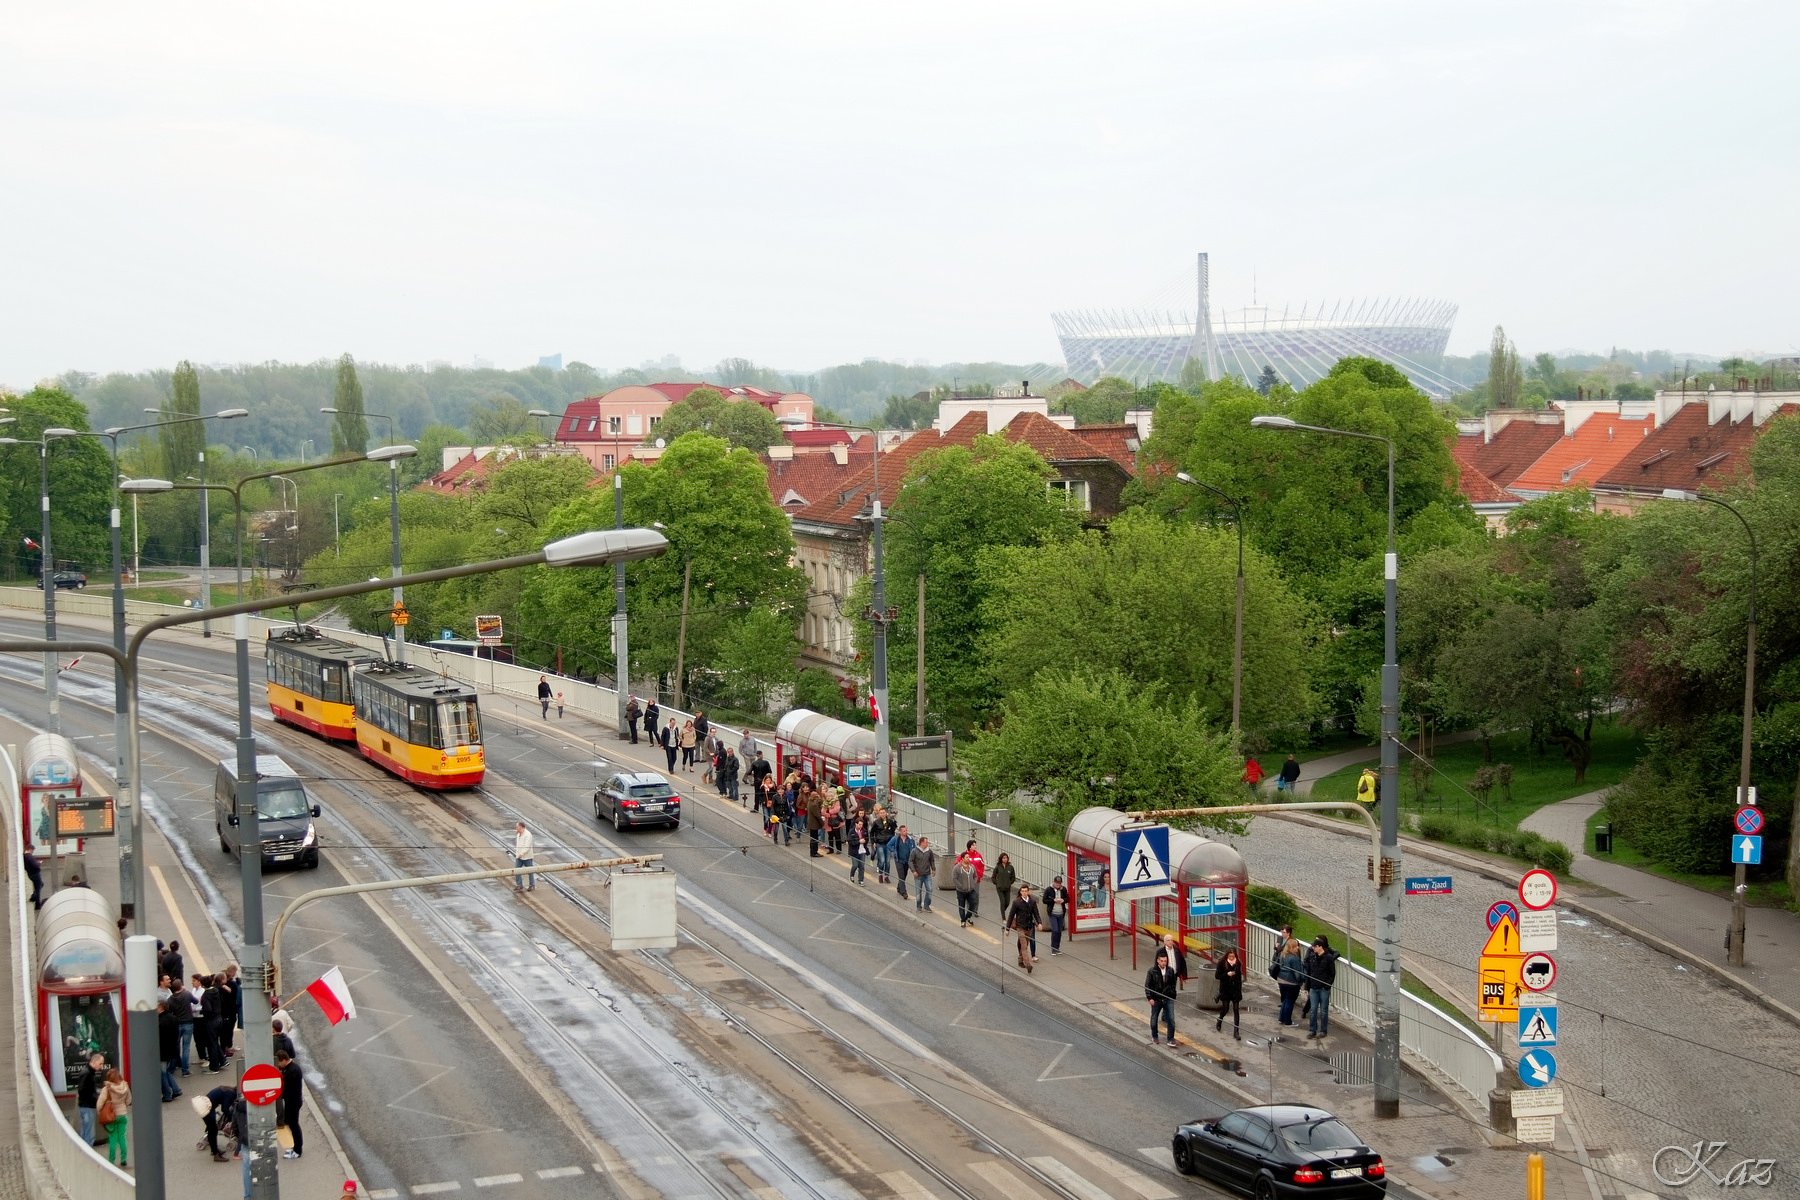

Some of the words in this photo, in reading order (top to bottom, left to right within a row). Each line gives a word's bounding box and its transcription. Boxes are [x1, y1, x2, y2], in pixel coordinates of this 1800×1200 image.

[444, 631, 451, 640] P
[1411, 882, 1430, 890] Nowy
[1431, 881, 1447, 890] Zjazd
[1483, 984, 1504, 996] BUS
